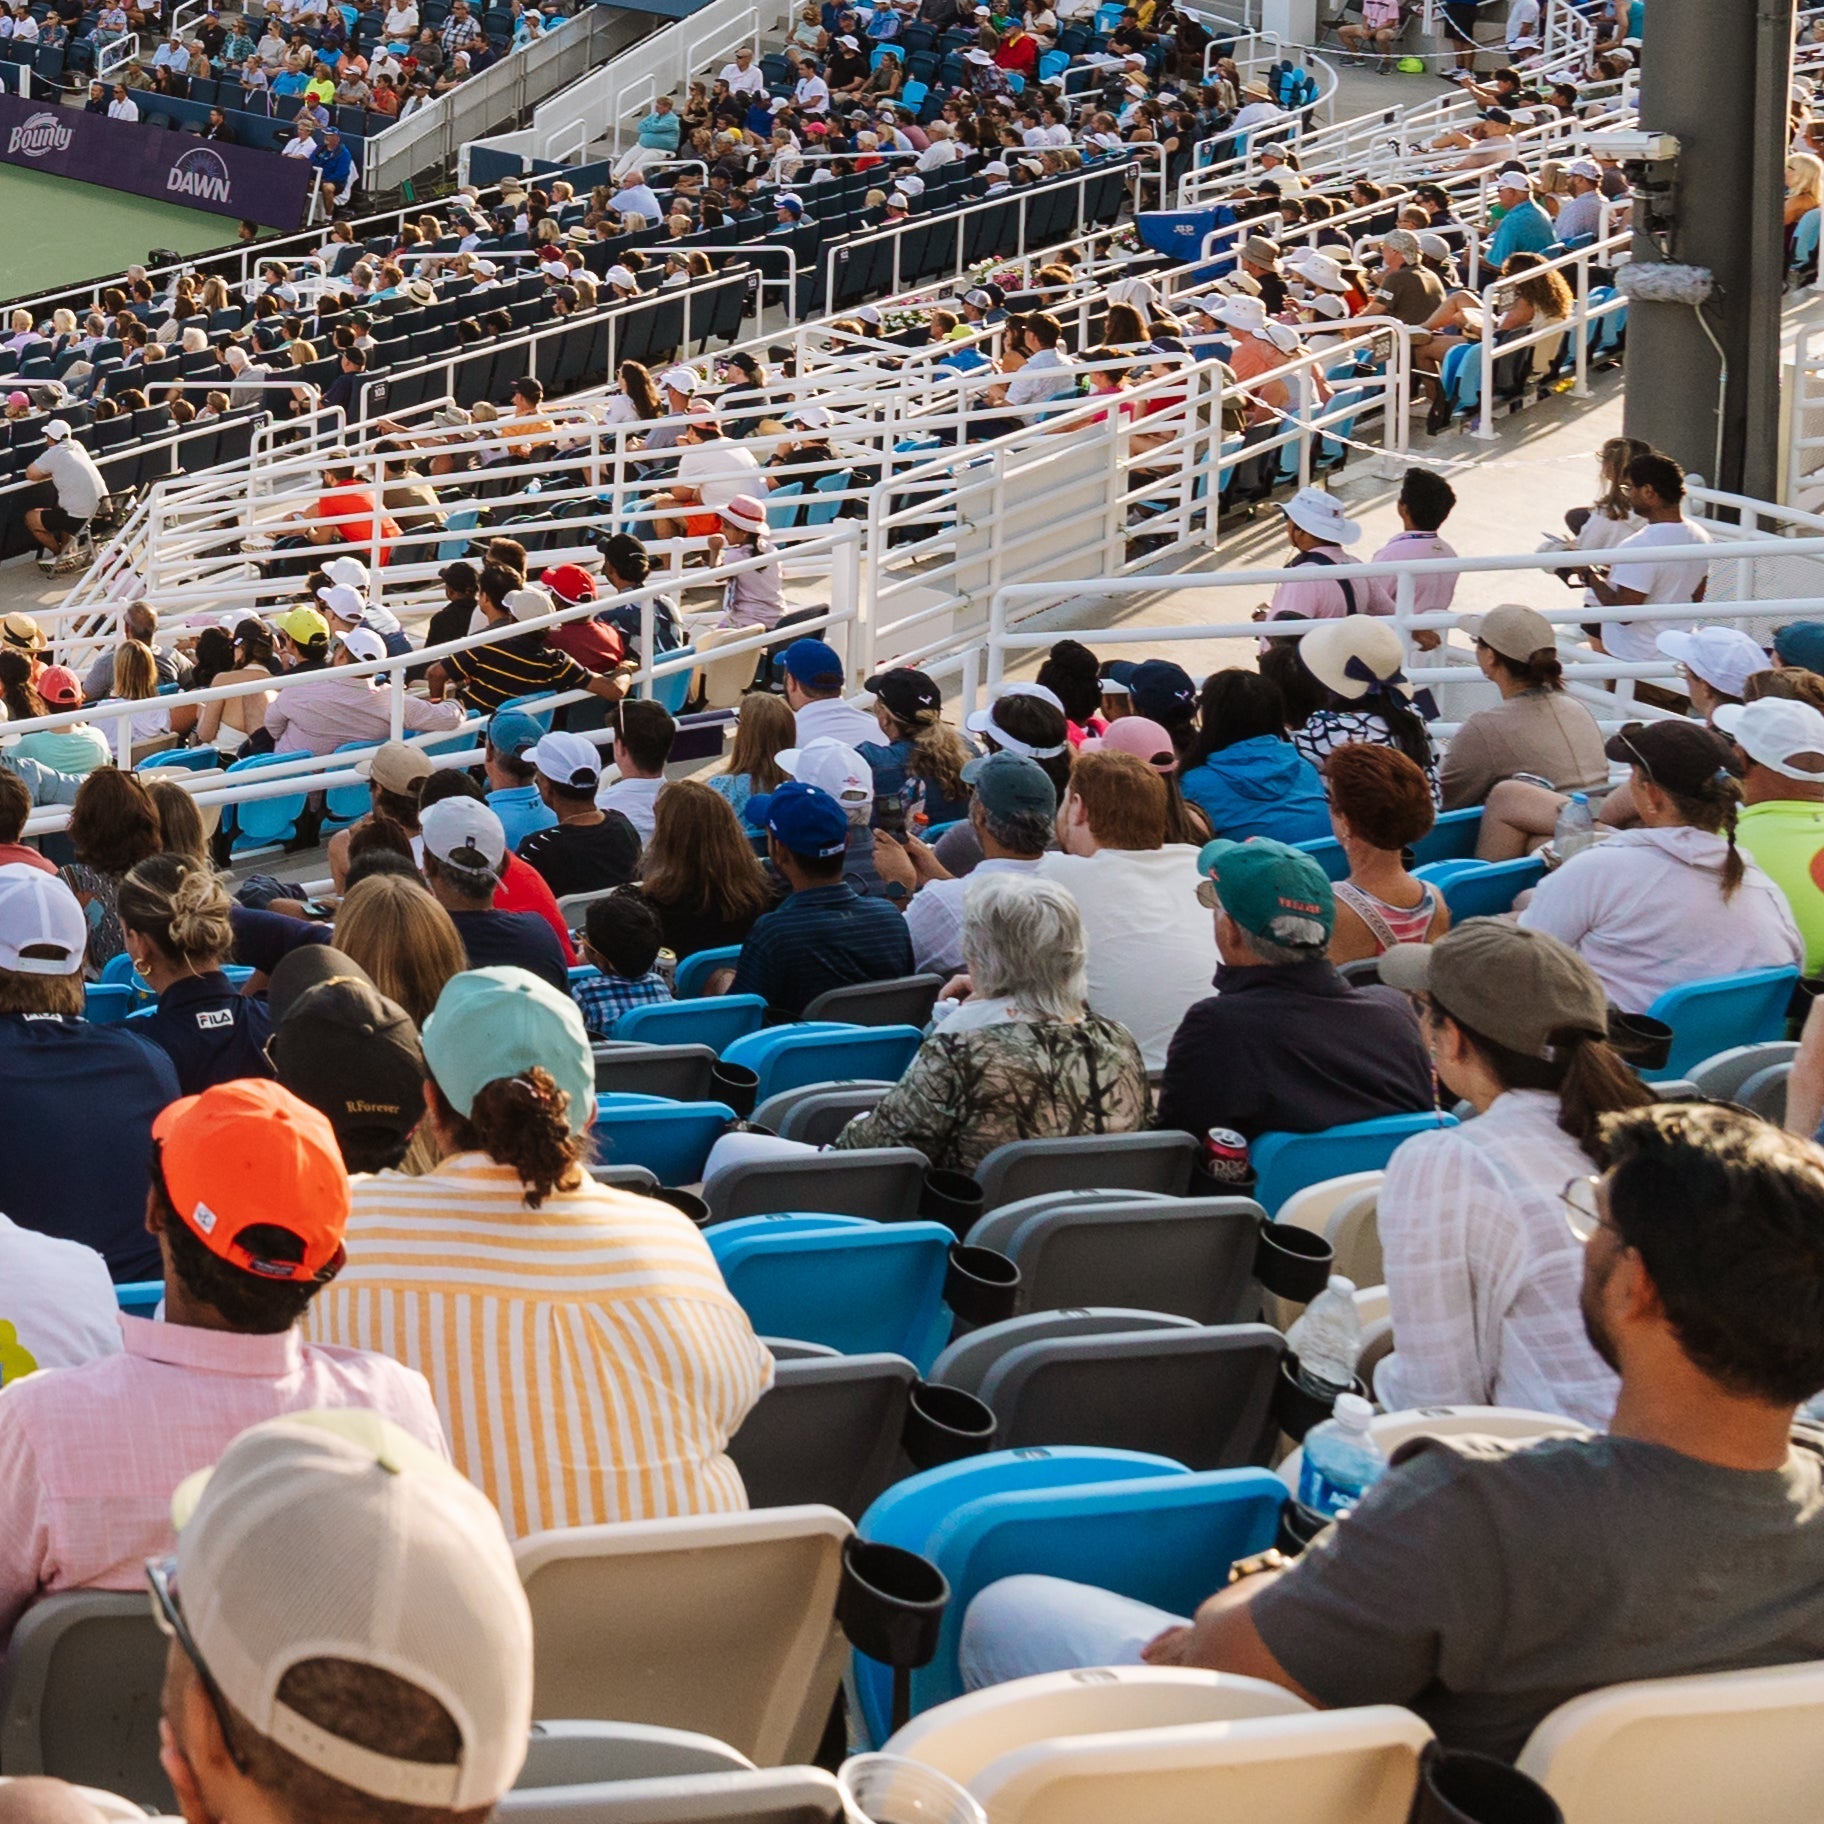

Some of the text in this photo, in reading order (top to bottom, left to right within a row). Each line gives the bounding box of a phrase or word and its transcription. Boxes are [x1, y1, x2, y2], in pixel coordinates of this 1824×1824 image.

[7, 124, 73, 154] Bounty
[166, 166, 231, 203] DAWN
[200, 1010, 233, 1027] FILA
